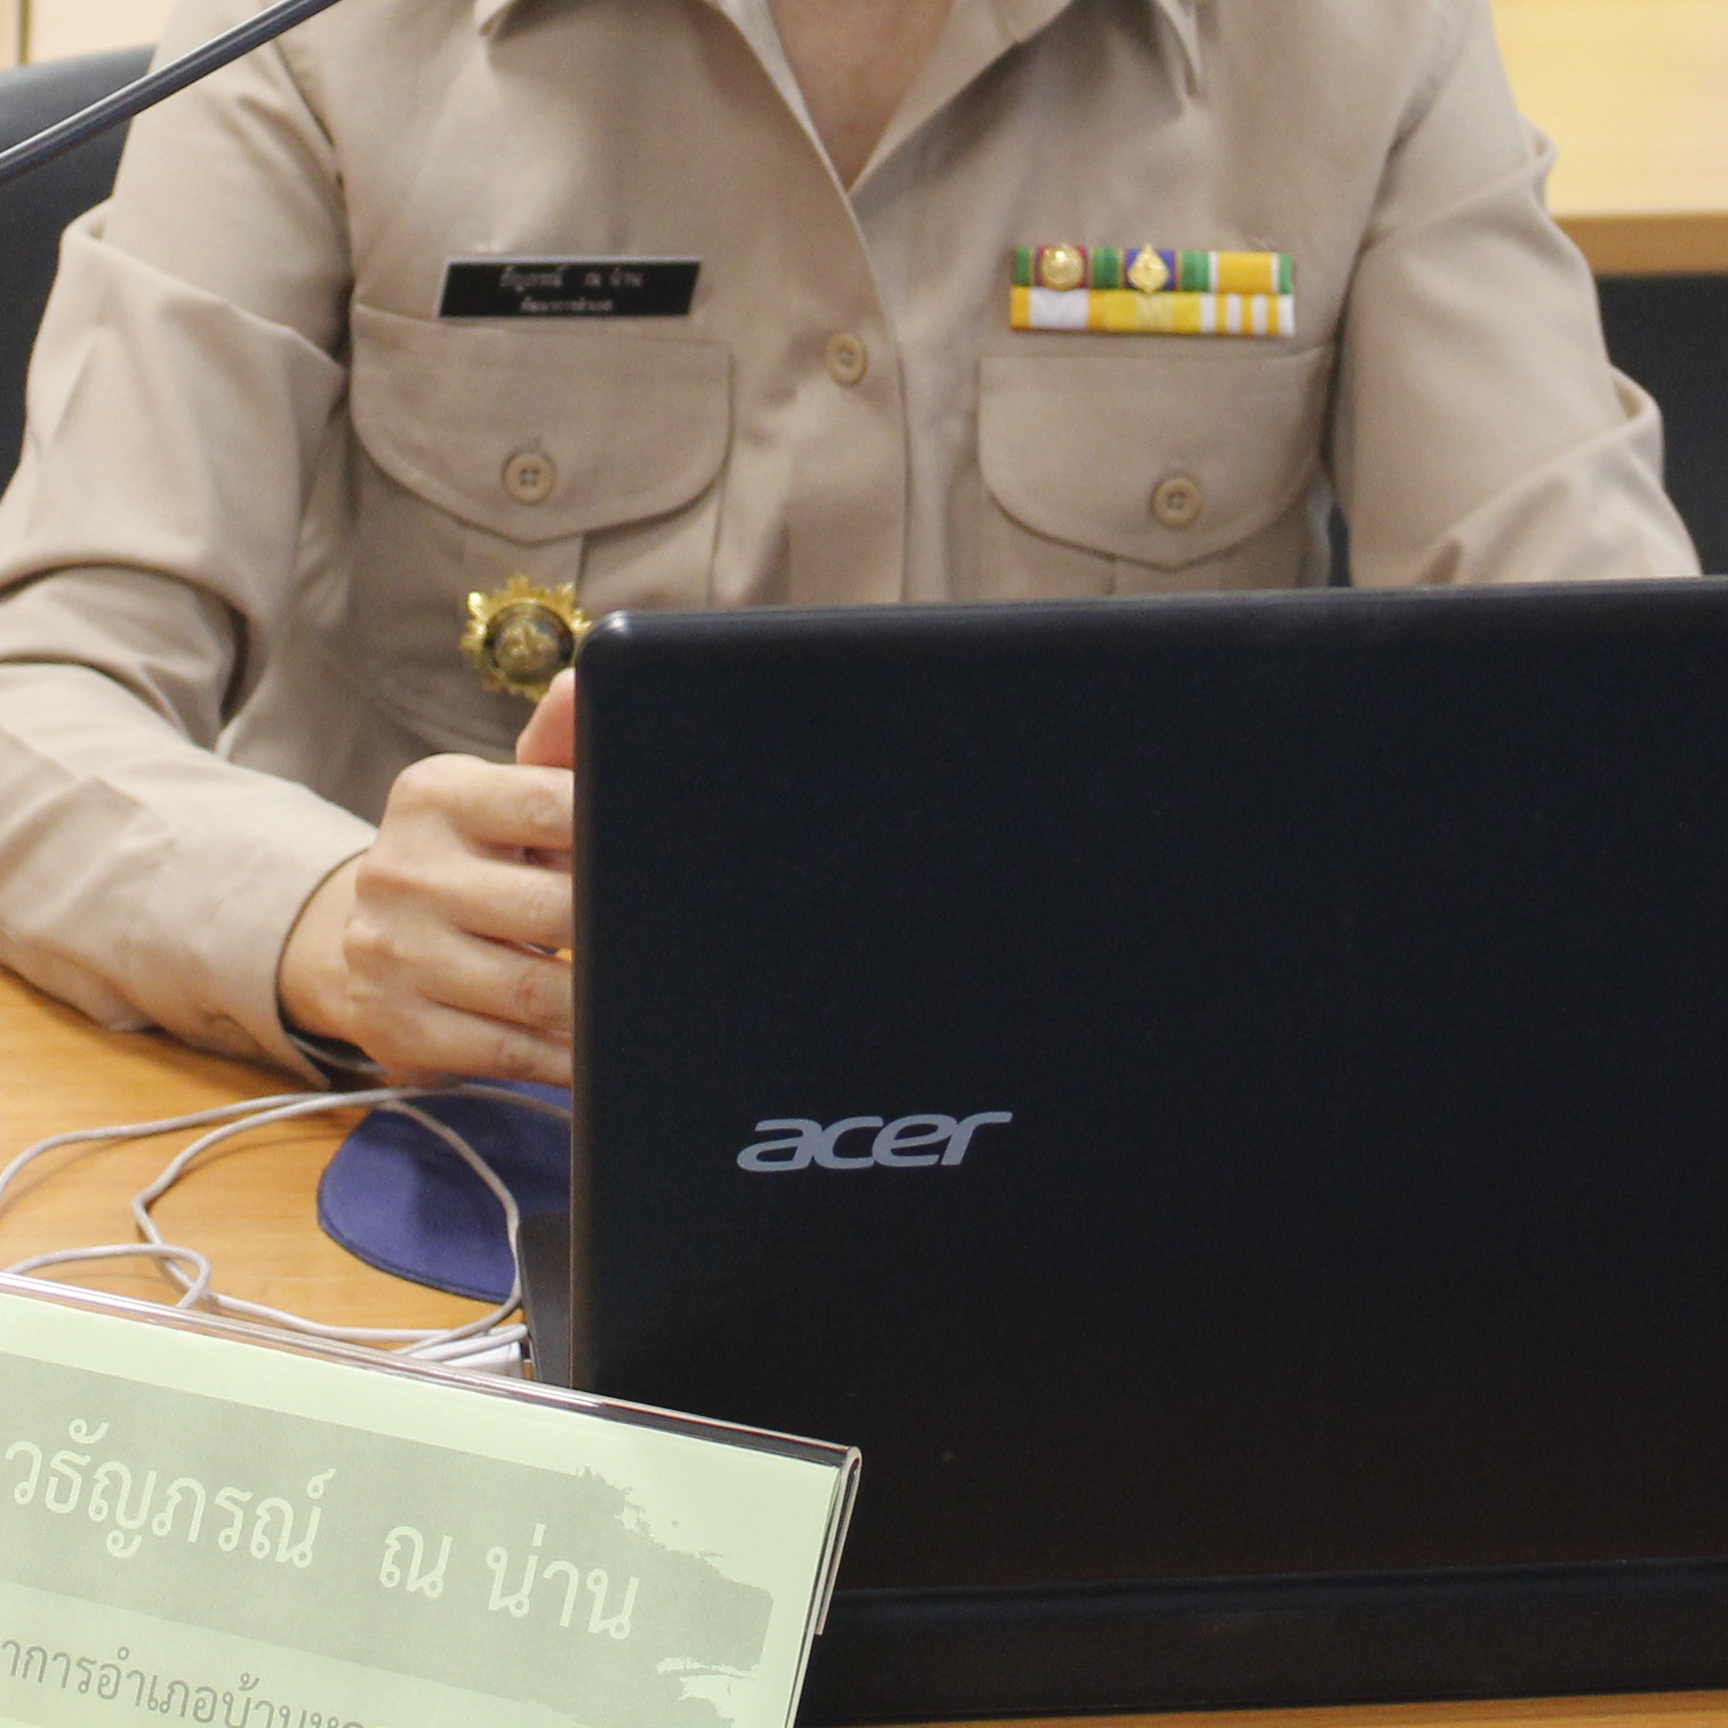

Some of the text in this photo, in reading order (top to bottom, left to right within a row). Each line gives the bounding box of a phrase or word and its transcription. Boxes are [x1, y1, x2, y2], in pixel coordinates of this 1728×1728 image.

[736, 1110, 1014, 1172] acer
[379, 1524, 454, 1599] ณ
[485, 1522, 640, 1640] น่าน
